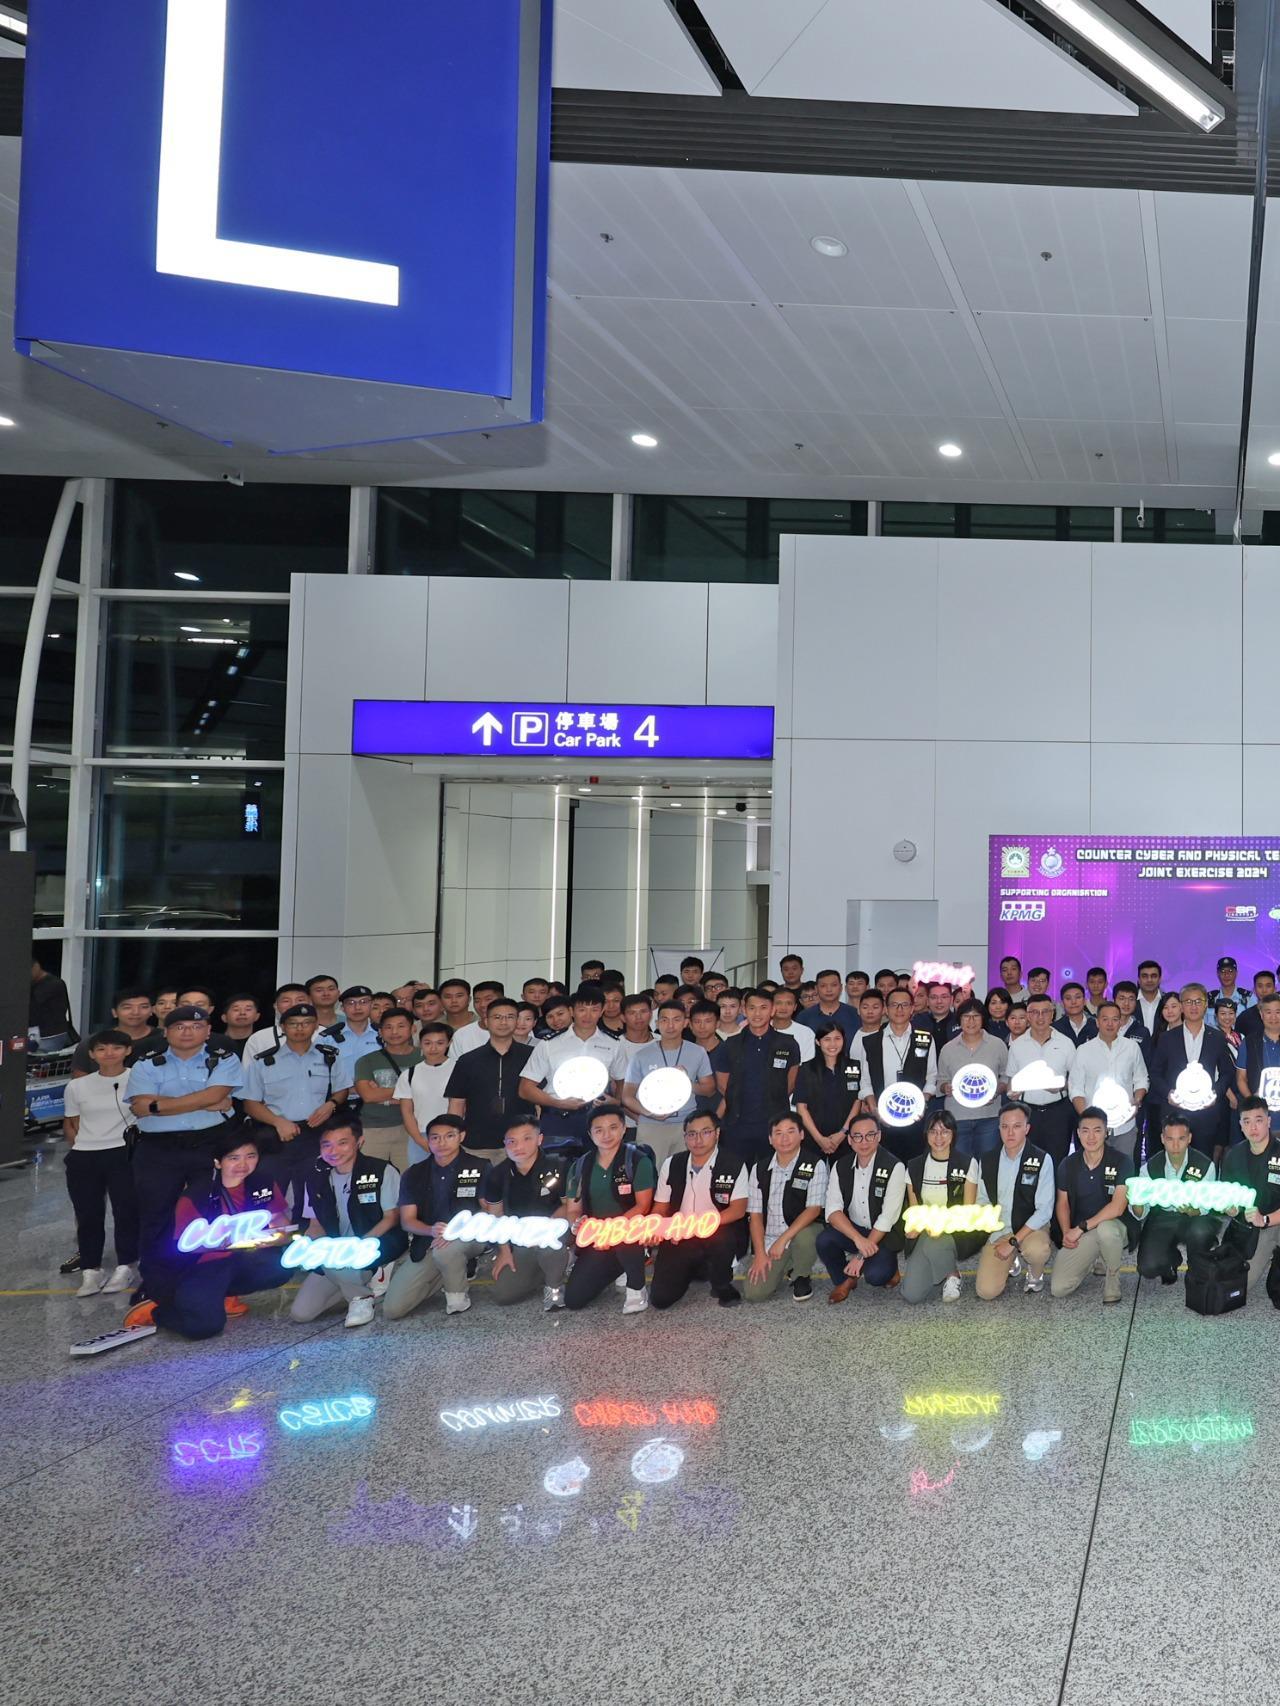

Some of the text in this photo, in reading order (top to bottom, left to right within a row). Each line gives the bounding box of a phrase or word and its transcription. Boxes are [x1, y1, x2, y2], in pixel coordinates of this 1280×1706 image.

[156, 0, 399, 306] L
[520, 716, 543, 742] P
[555, 712, 619, 730] 停車場
[554, 733, 621, 747] Car Park
[633, 715, 660, 748] 4
[1076, 849, 1132, 860] COUNTER
[1135, 850, 1175, 860] CYBER
[1178, 850, 1202, 860] AND
[1205, 850, 1261, 861] PHYSICAL
[1138, 867, 1268, 878] JOINT EXERCISE 2024
[1000, 888, 1108, 897] SUPPORTING ORGANISATION
[1000, 908, 1043, 920] KPMG
[177, 1209, 272, 1253] CCTR
[575, 1210, 721, 1250] CYBER AND
